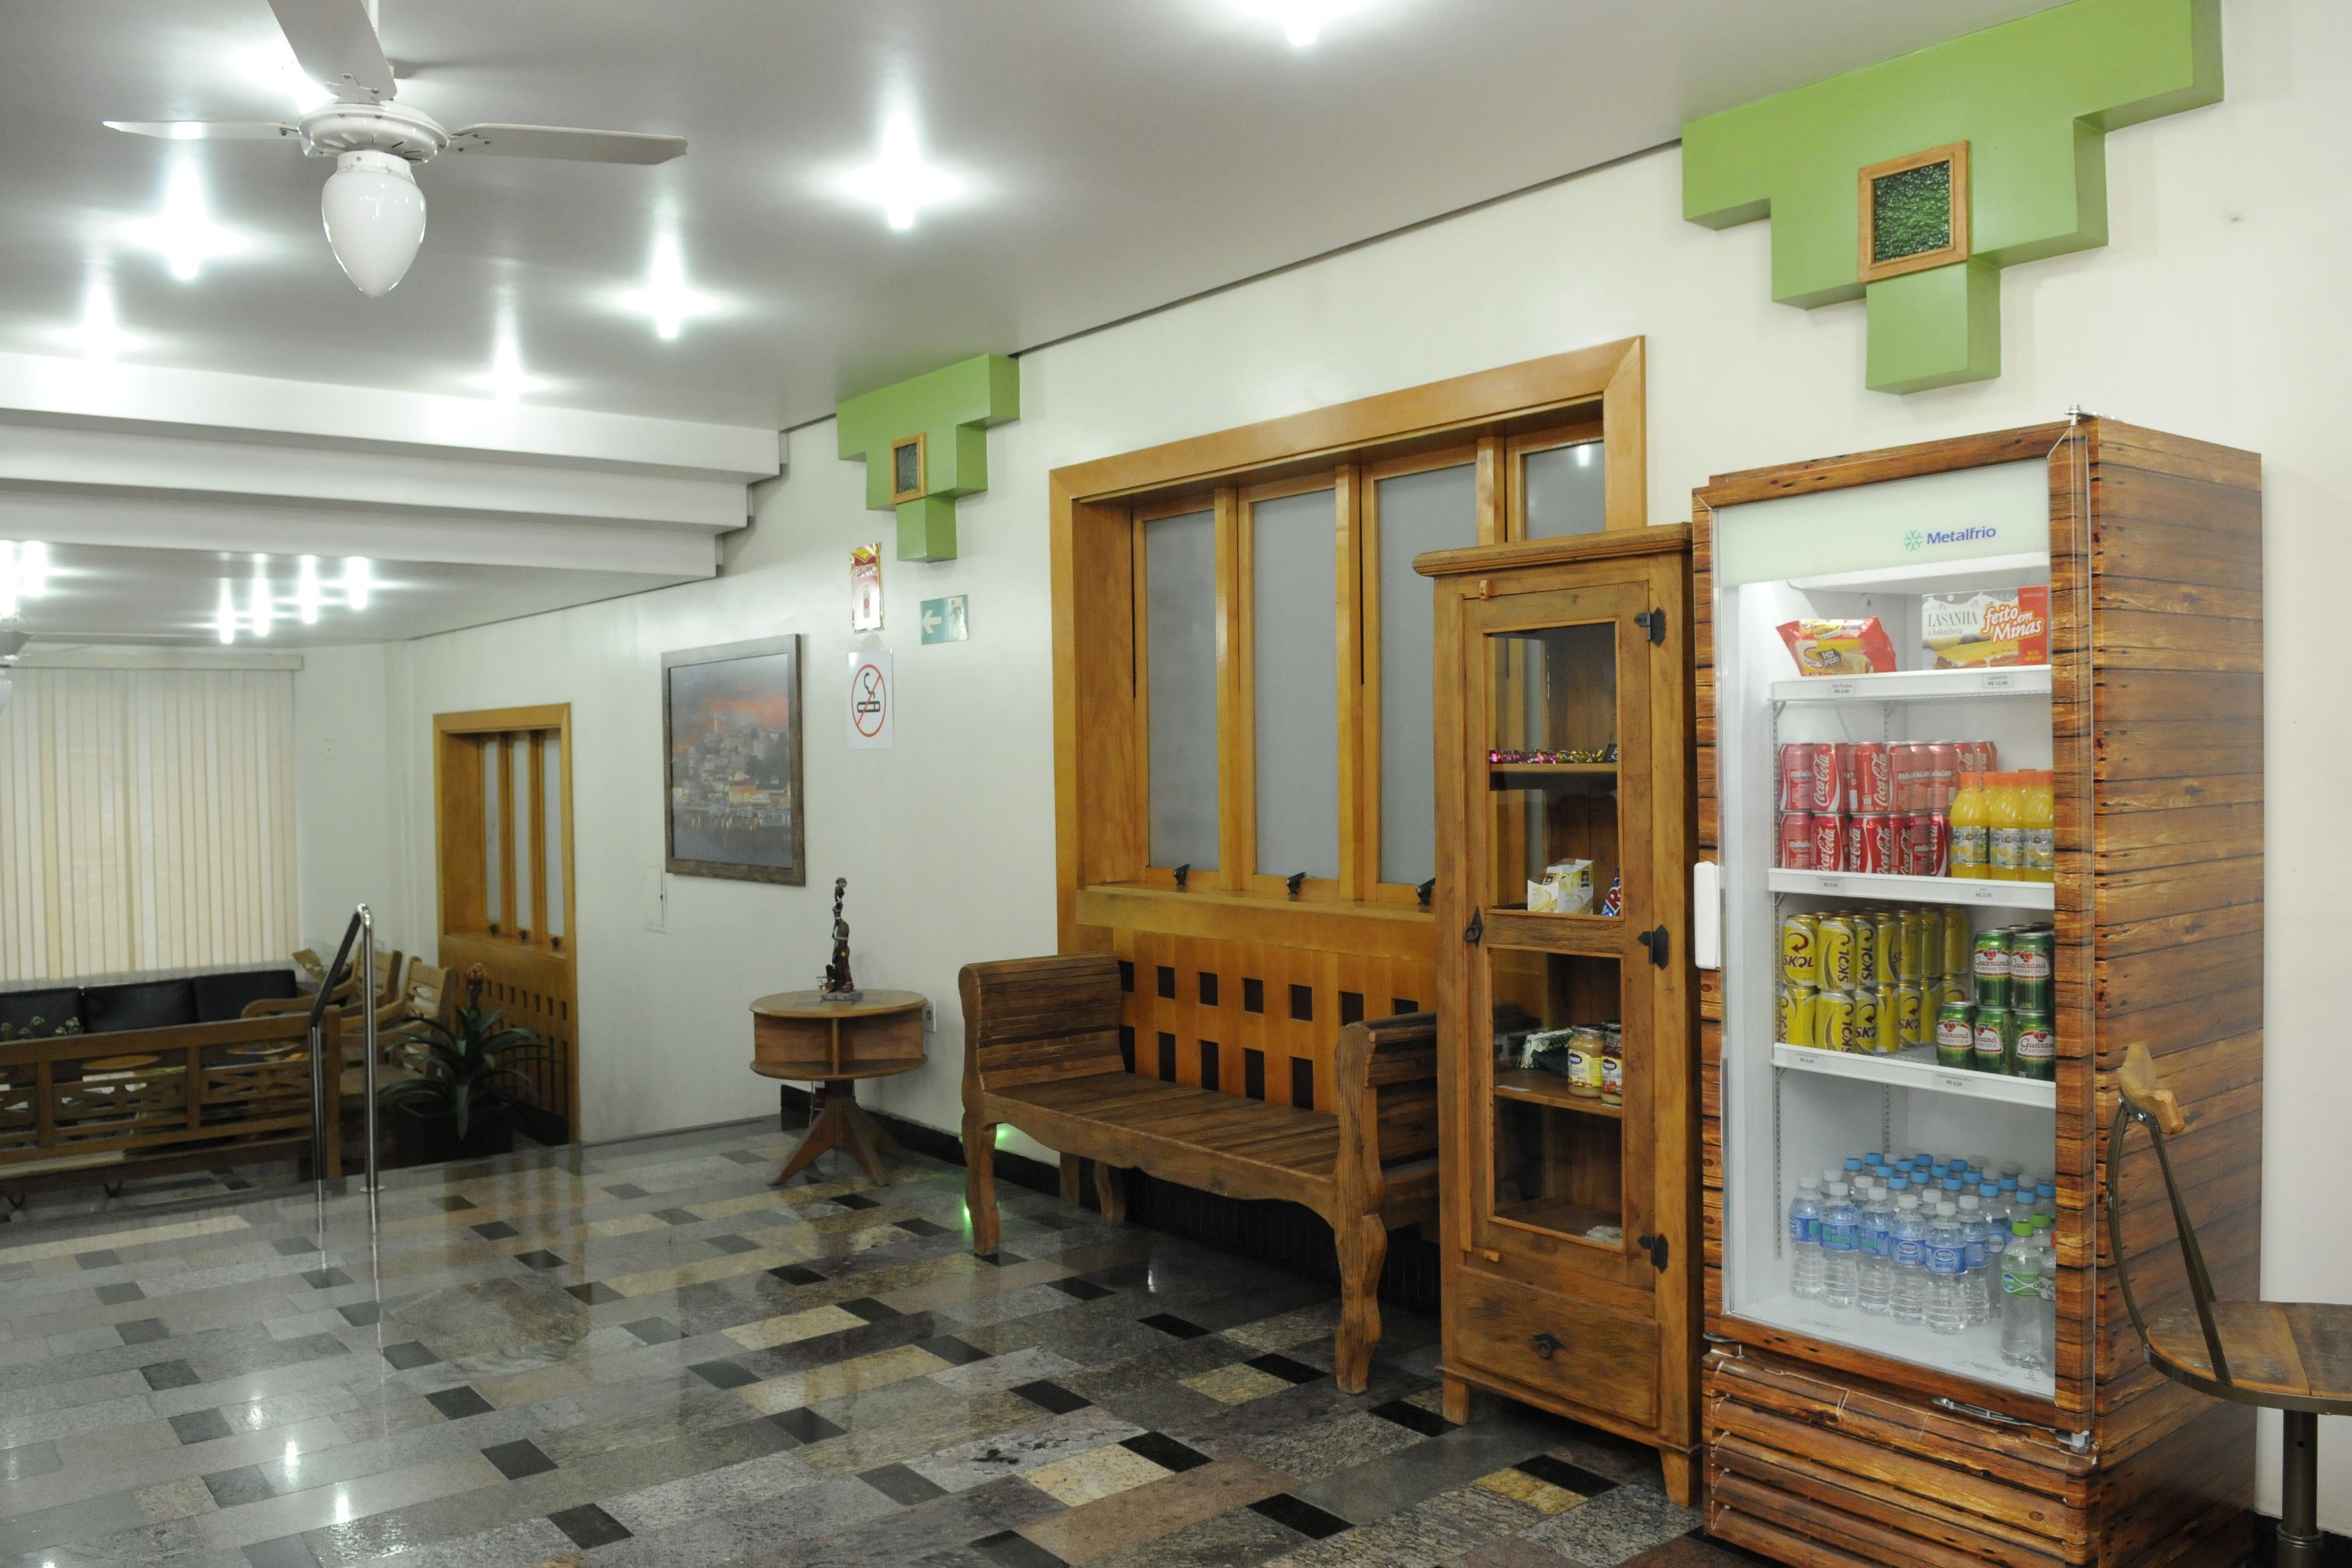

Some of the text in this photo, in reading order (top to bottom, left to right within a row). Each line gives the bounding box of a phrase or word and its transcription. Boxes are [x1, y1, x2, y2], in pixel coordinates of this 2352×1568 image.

[1926, 526, 1996, 544] Metalfrio
[1928, 611, 1978, 627] LASANHA
[1982, 604, 2033, 633] feito em
[1992, 619, 2043, 643] Minas
[1783, 955, 1814, 969] SKOL
[1838, 949, 1850, 983] SKOL
[1861, 945, 1873, 981] SKOL
[2020, 1038, 2055, 1052] Guaran
